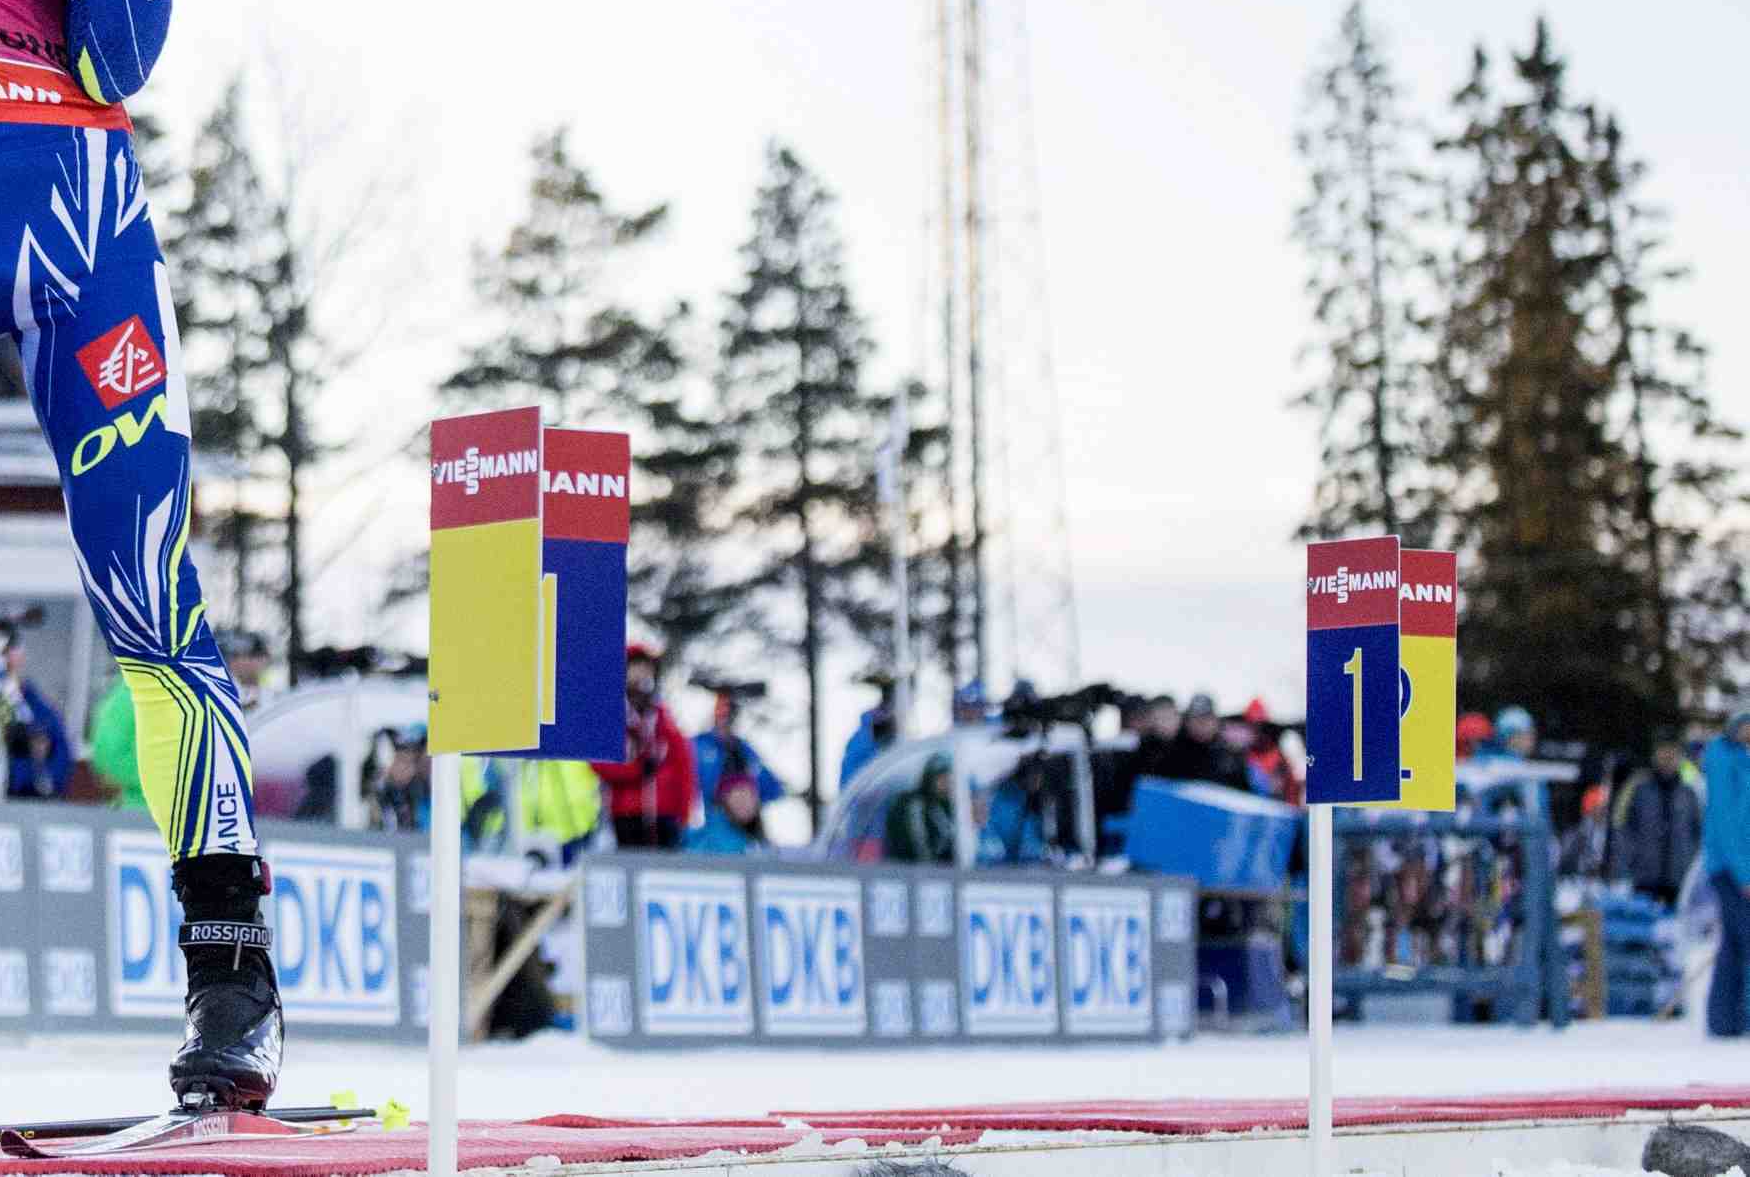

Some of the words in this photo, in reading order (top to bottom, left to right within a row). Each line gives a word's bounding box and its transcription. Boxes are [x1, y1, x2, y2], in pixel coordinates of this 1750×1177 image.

[434, 447, 538, 495] VIESSMANN
[1309, 566, 1397, 604] VIESSMANN
[1344, 647, 1362, 781] 1
[272, 876, 389, 993] DKB
[646, 901, 746, 1005] DKB
